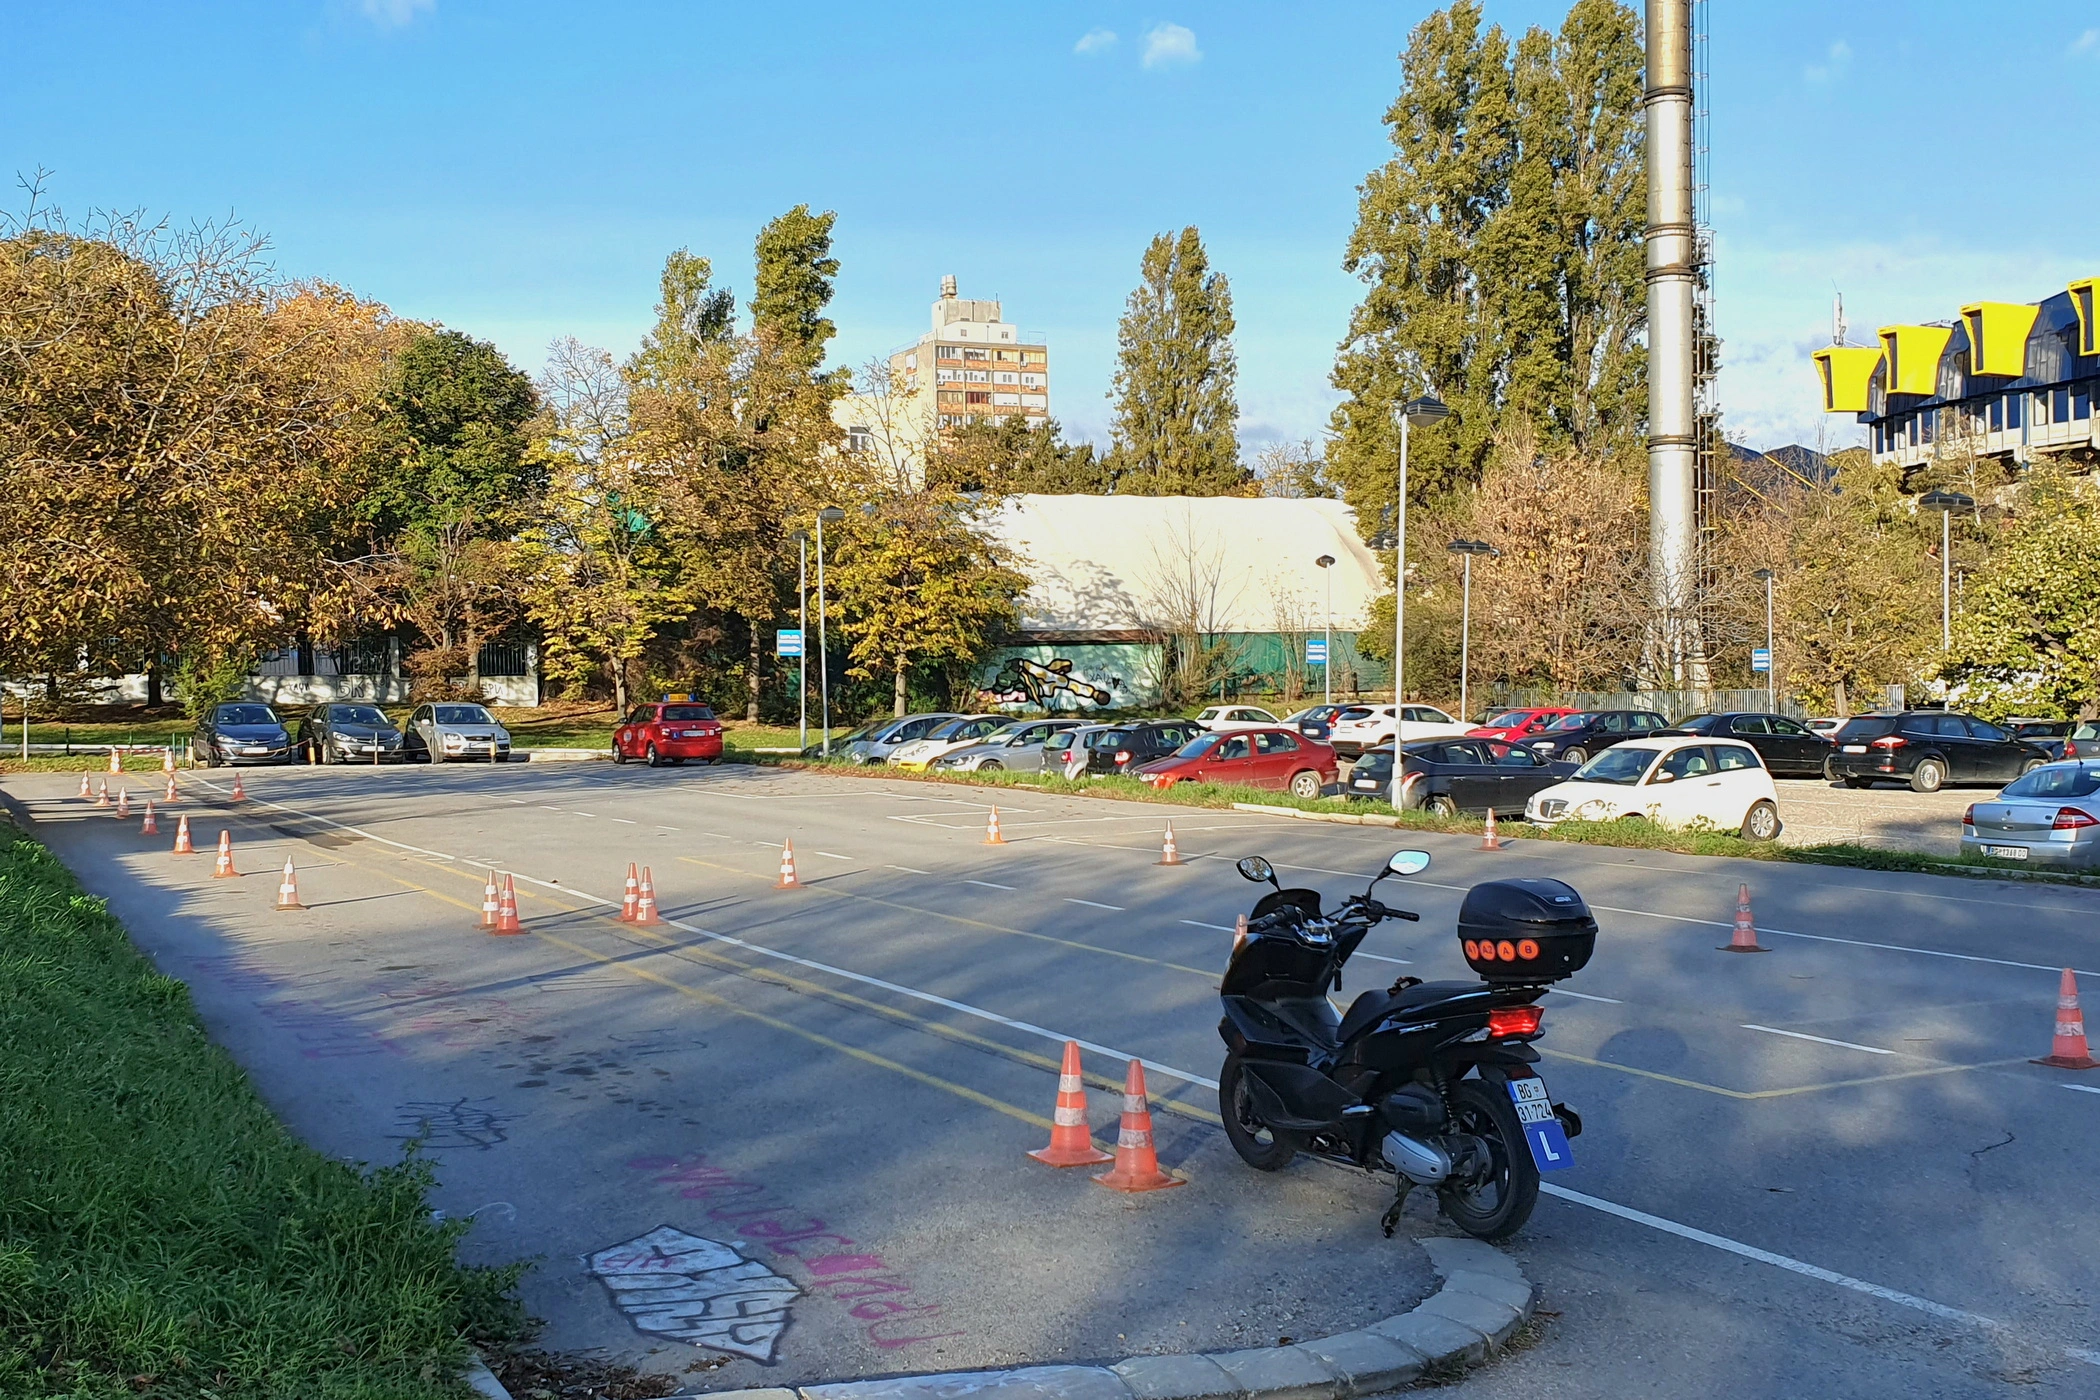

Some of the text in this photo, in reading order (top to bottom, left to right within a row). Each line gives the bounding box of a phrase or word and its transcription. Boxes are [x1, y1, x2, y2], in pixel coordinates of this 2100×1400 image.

[1483, 945, 1493, 955] A2
[1525, 945, 1532, 954] B
[1517, 1083, 1532, 1099] BG
[1538, 1130, 1560, 1161] L
